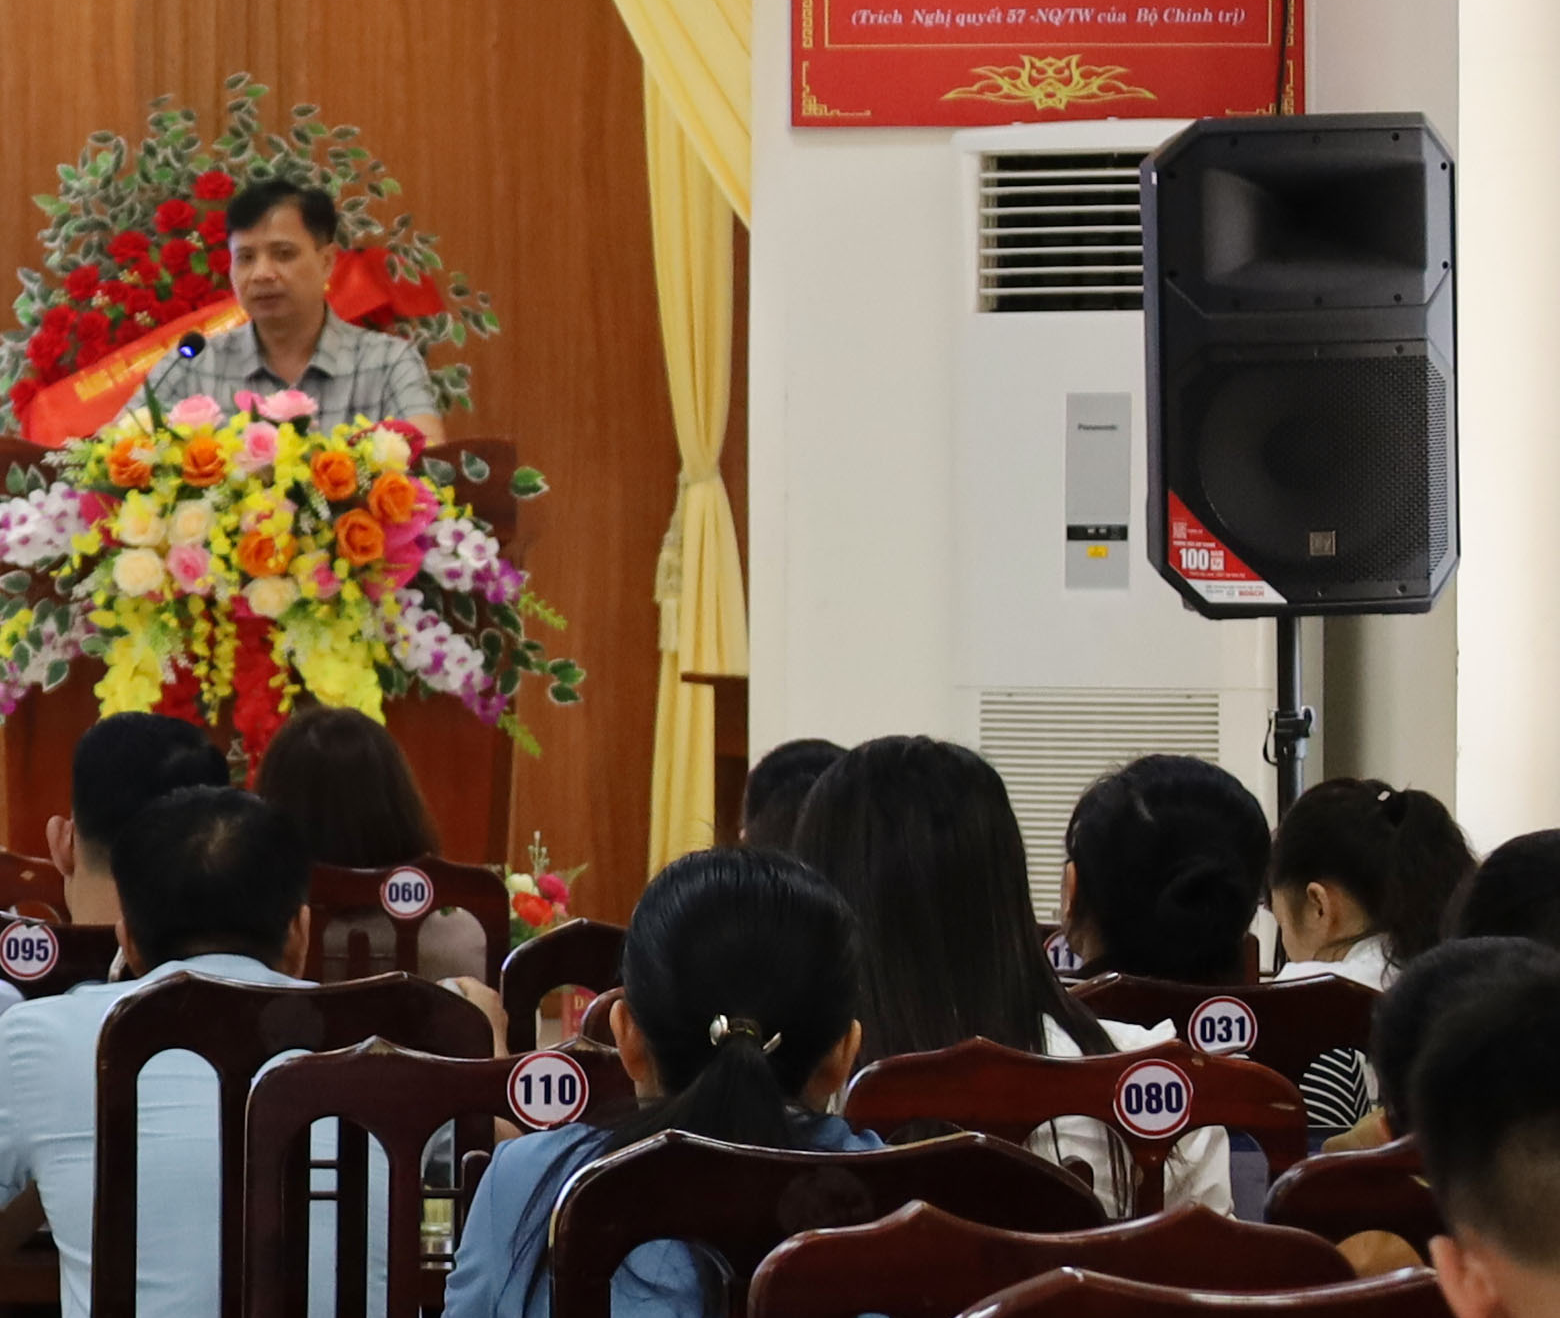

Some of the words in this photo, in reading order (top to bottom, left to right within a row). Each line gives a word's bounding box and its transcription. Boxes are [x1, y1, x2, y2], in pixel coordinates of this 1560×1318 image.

[1180, 548, 1209, 570] 100
[389, 883, 424, 902] 060
[6, 937, 49, 961] 095
[1200, 1016, 1246, 1042] 031
[520, 1074, 576, 1105] 110
[1125, 1086, 1182, 1114] 080
